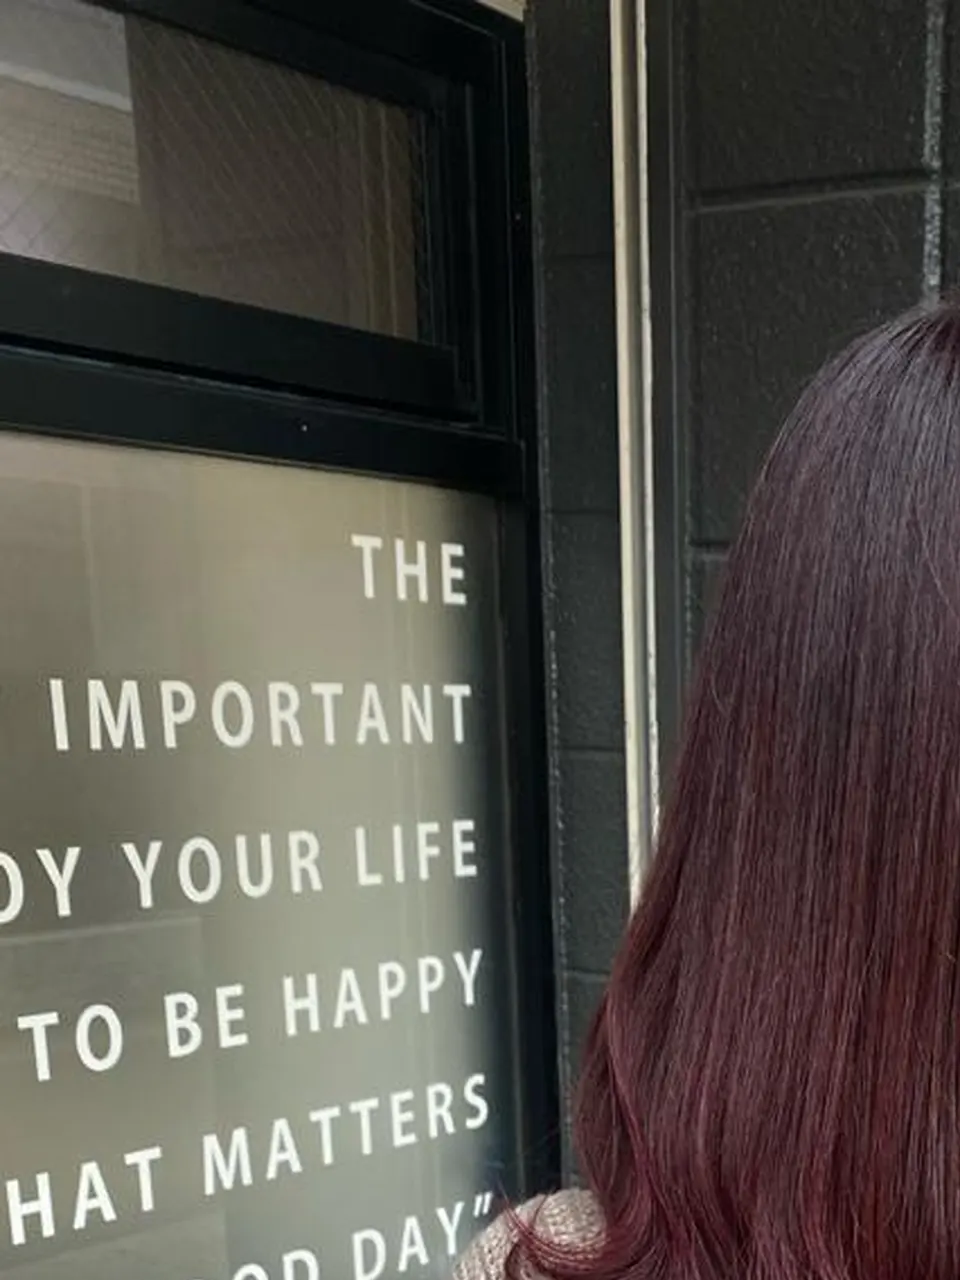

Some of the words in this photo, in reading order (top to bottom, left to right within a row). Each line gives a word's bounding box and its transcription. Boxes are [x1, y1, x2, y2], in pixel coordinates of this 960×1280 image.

[351, 533, 467, 606] THE
[49, 678, 471, 751] IMPORTANT
[121, 830, 323, 909] YOUR
[354, 819, 477, 888] LIFE
[17, 1004, 123, 1082] TO
[163, 984, 249, 1058] BE
[282, 949, 483, 1037] HAPPY
[5, 1146, 162, 1246] HAT
[202, 1073, 489, 1196] MATTERS
